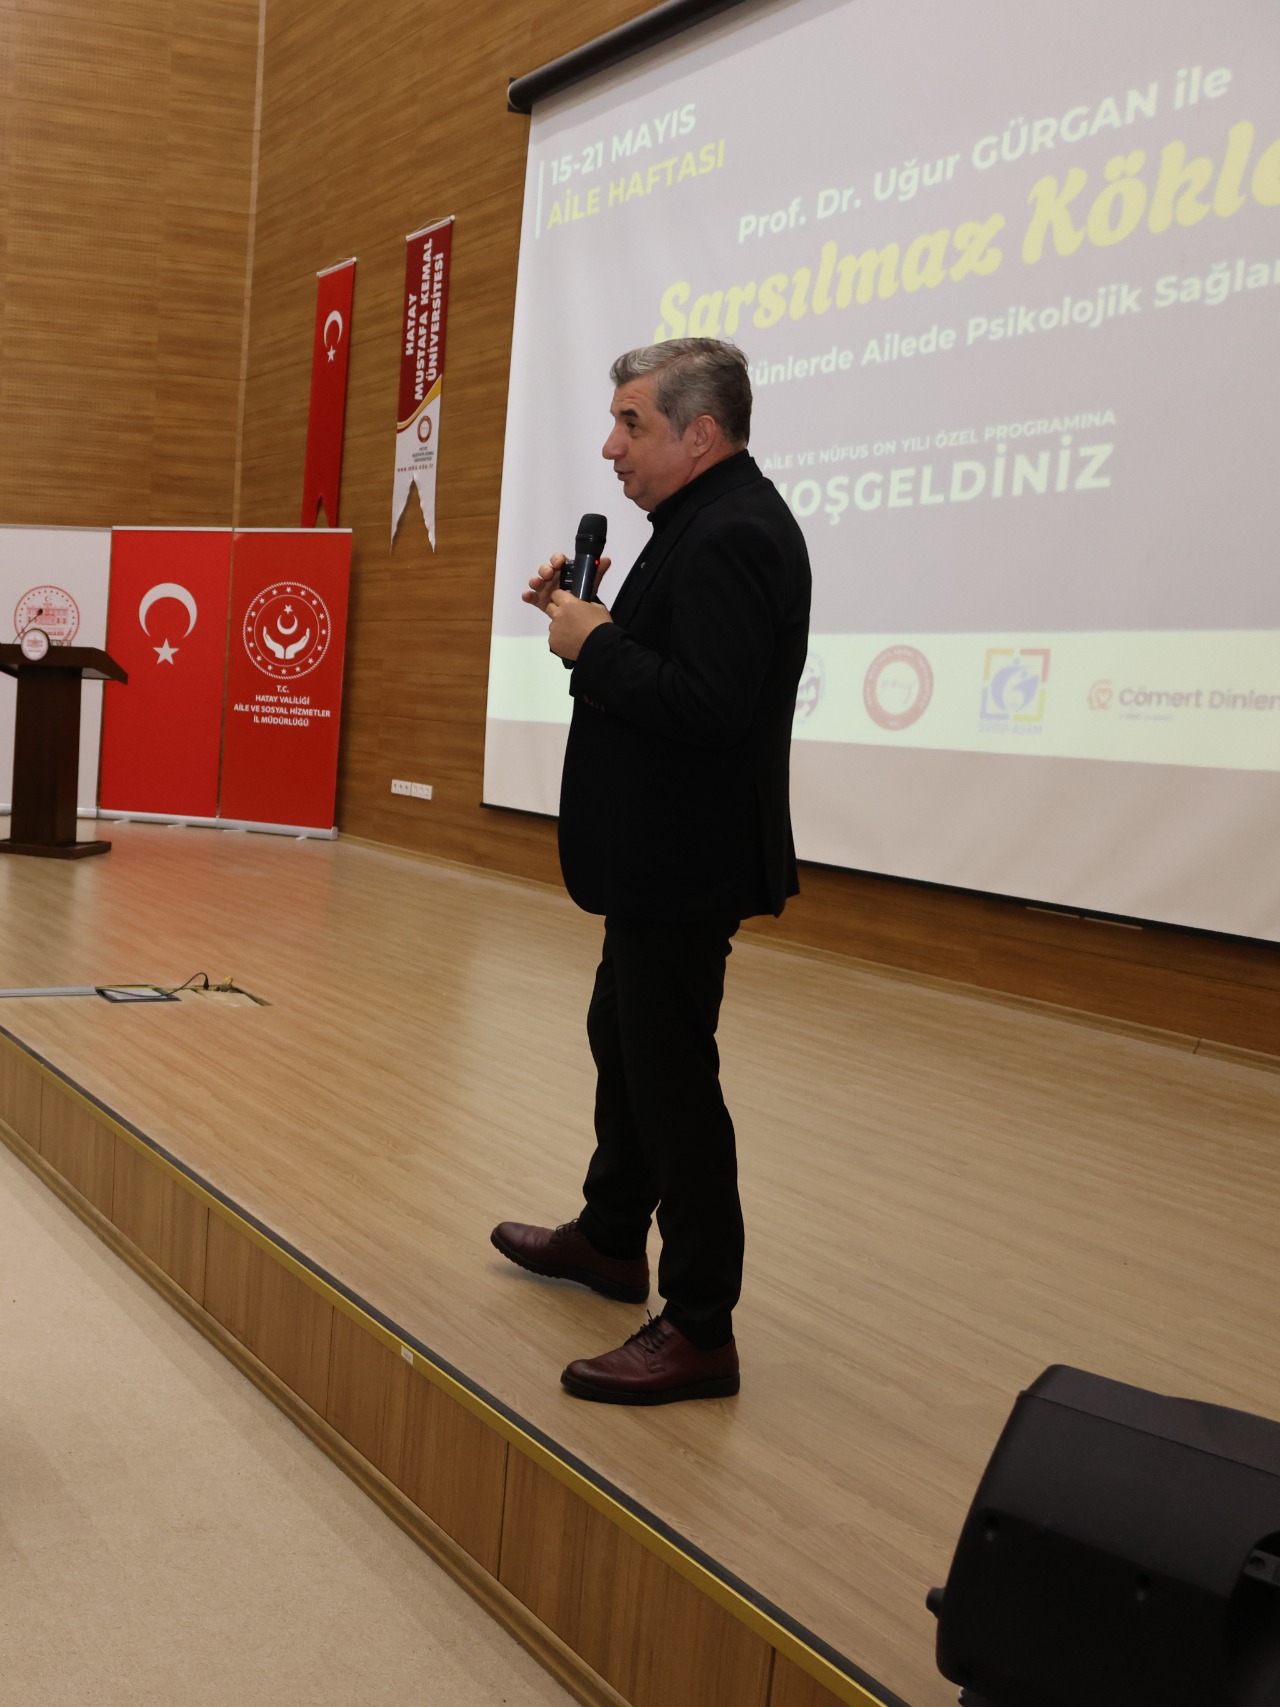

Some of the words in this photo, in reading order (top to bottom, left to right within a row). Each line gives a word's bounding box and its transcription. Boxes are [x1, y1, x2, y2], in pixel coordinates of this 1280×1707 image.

[551, 141, 604, 186] 15-21
[610, 103, 696, 163] MAYIS
[738, 196, 806, 244] Prof.
[817, 186, 862, 219] Dr.
[873, 153, 961, 202] Uğur
[971, 81, 1159, 170] GÜRGAN
[1174, 64, 1233, 110] ile
[547, 187, 601, 230] AİLE
[607, 138, 726, 209] HAFTASI
[420, 238, 433, 306] KEMAL
[653, 212, 1006, 344] Sarsılmaz
[405, 293, 418, 356] HATAY
[425, 252, 444, 382] ÜNİVERSİTESİ
[860, 324, 957, 366] Ailede
[966, 282, 1143, 346] Psikolojik
[1153, 258, 1280, 308] Sağla
[414, 310, 428, 400] MUSTAFA
[763, 453, 792, 470] AİLE
[797, 451, 815, 466] VE
[873, 440, 896, 456] ON
[900, 435, 930, 452] YILI
[935, 427, 978, 449] ÖZEL
[984, 409, 1115, 441] PROGRAMINA
[233, 703, 249, 711] AİLE
[261, 705, 288, 714] SOSYAL
[289, 706, 331, 717] HİZMETLER
[253, 714, 260, 723] İL
[261, 715, 309, 726] MÜDÜRLÜĞÜ
[255, 694, 278, 702] HATAY
[279, 695, 310, 705] VALİLİĞİ
[276, 685, 289, 693] T.C.
[1119, 685, 1203, 710] Cömert
